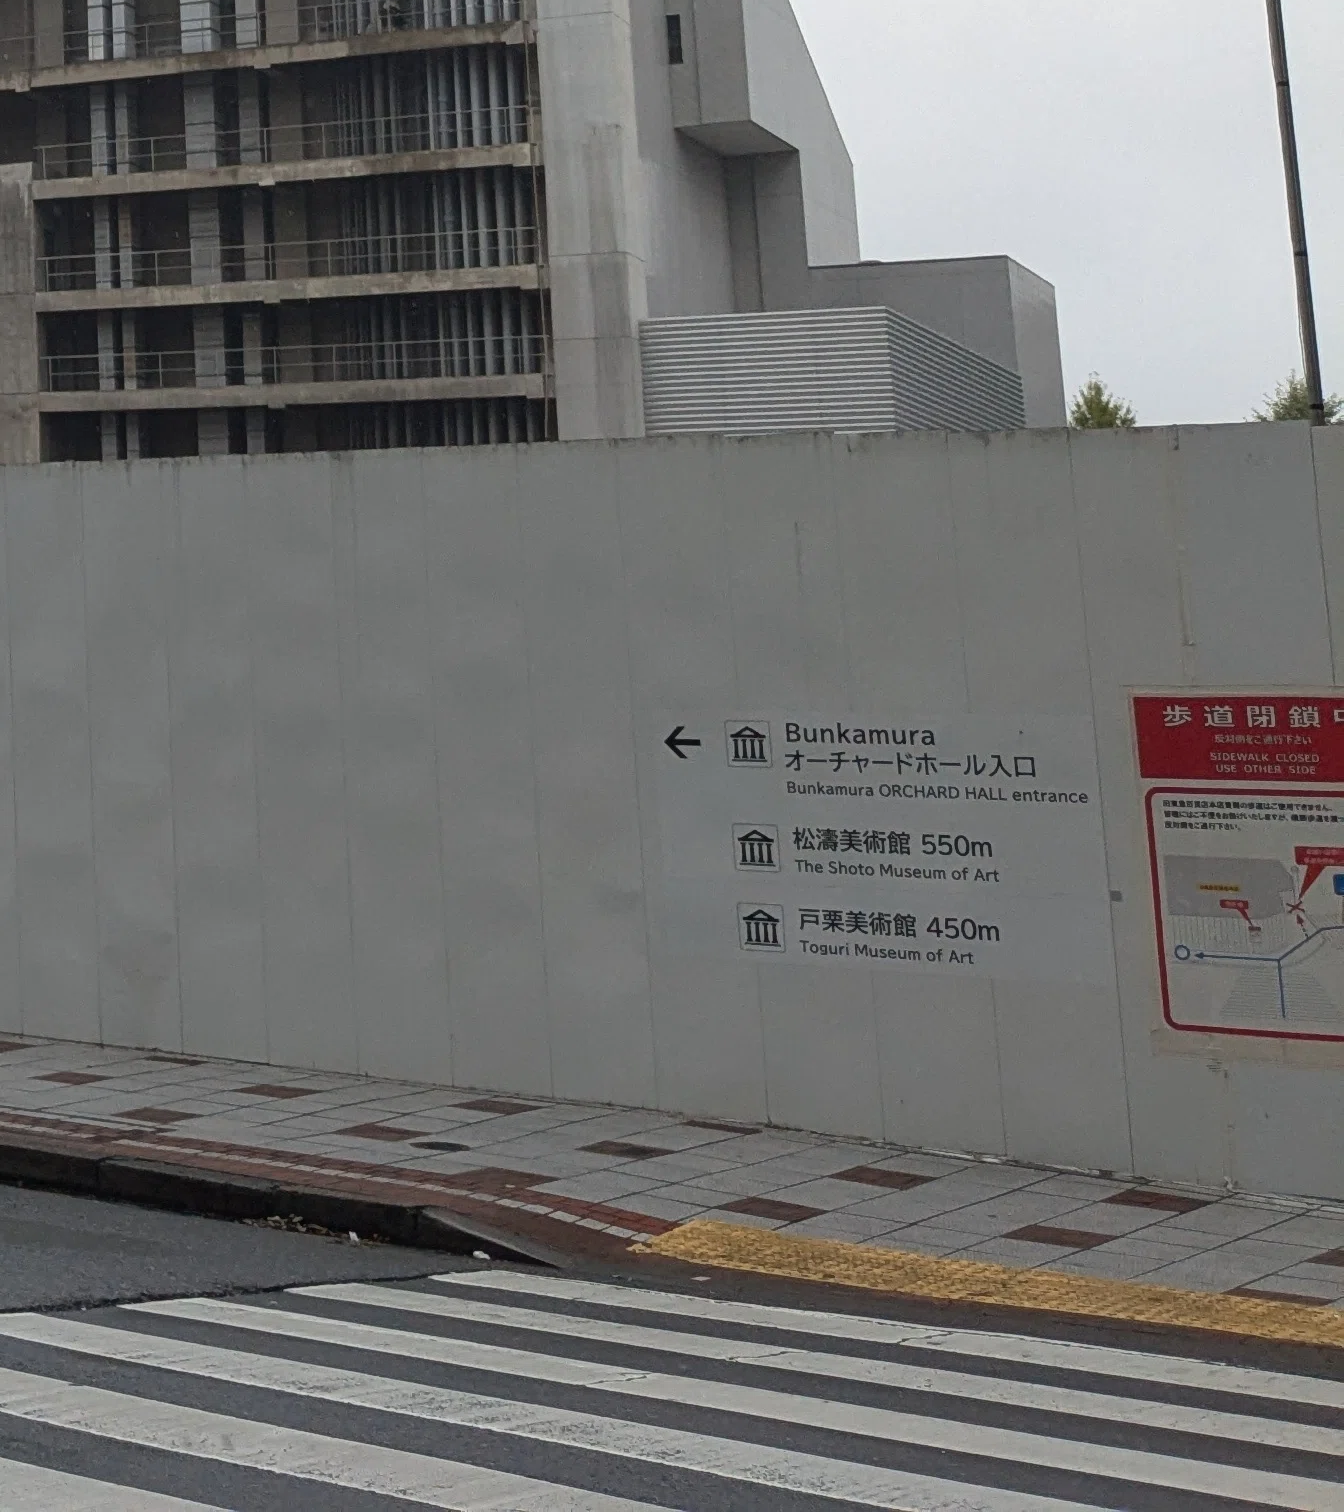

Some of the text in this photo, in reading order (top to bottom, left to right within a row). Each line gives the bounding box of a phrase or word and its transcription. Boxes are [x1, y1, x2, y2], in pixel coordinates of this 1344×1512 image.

[785, 722, 935, 746] Bunkamura
[784, 749, 1036, 778] オーチャードホール入口
[1210, 751, 1320, 763] SIDEWALK CLOSED
[1215, 764, 1316, 775] USE OTHER SIDE
[786, 781, 1089, 804] Bunkamura ORCHARD HALL entrance
[792, 826, 993, 858] 松濤美術館 550m
[795, 859, 1000, 882] The Shoto Museum of Art
[798, 908, 1001, 942] 戸栗美術館 450m
[799, 940, 975, 965] Toguri Museum of Art
